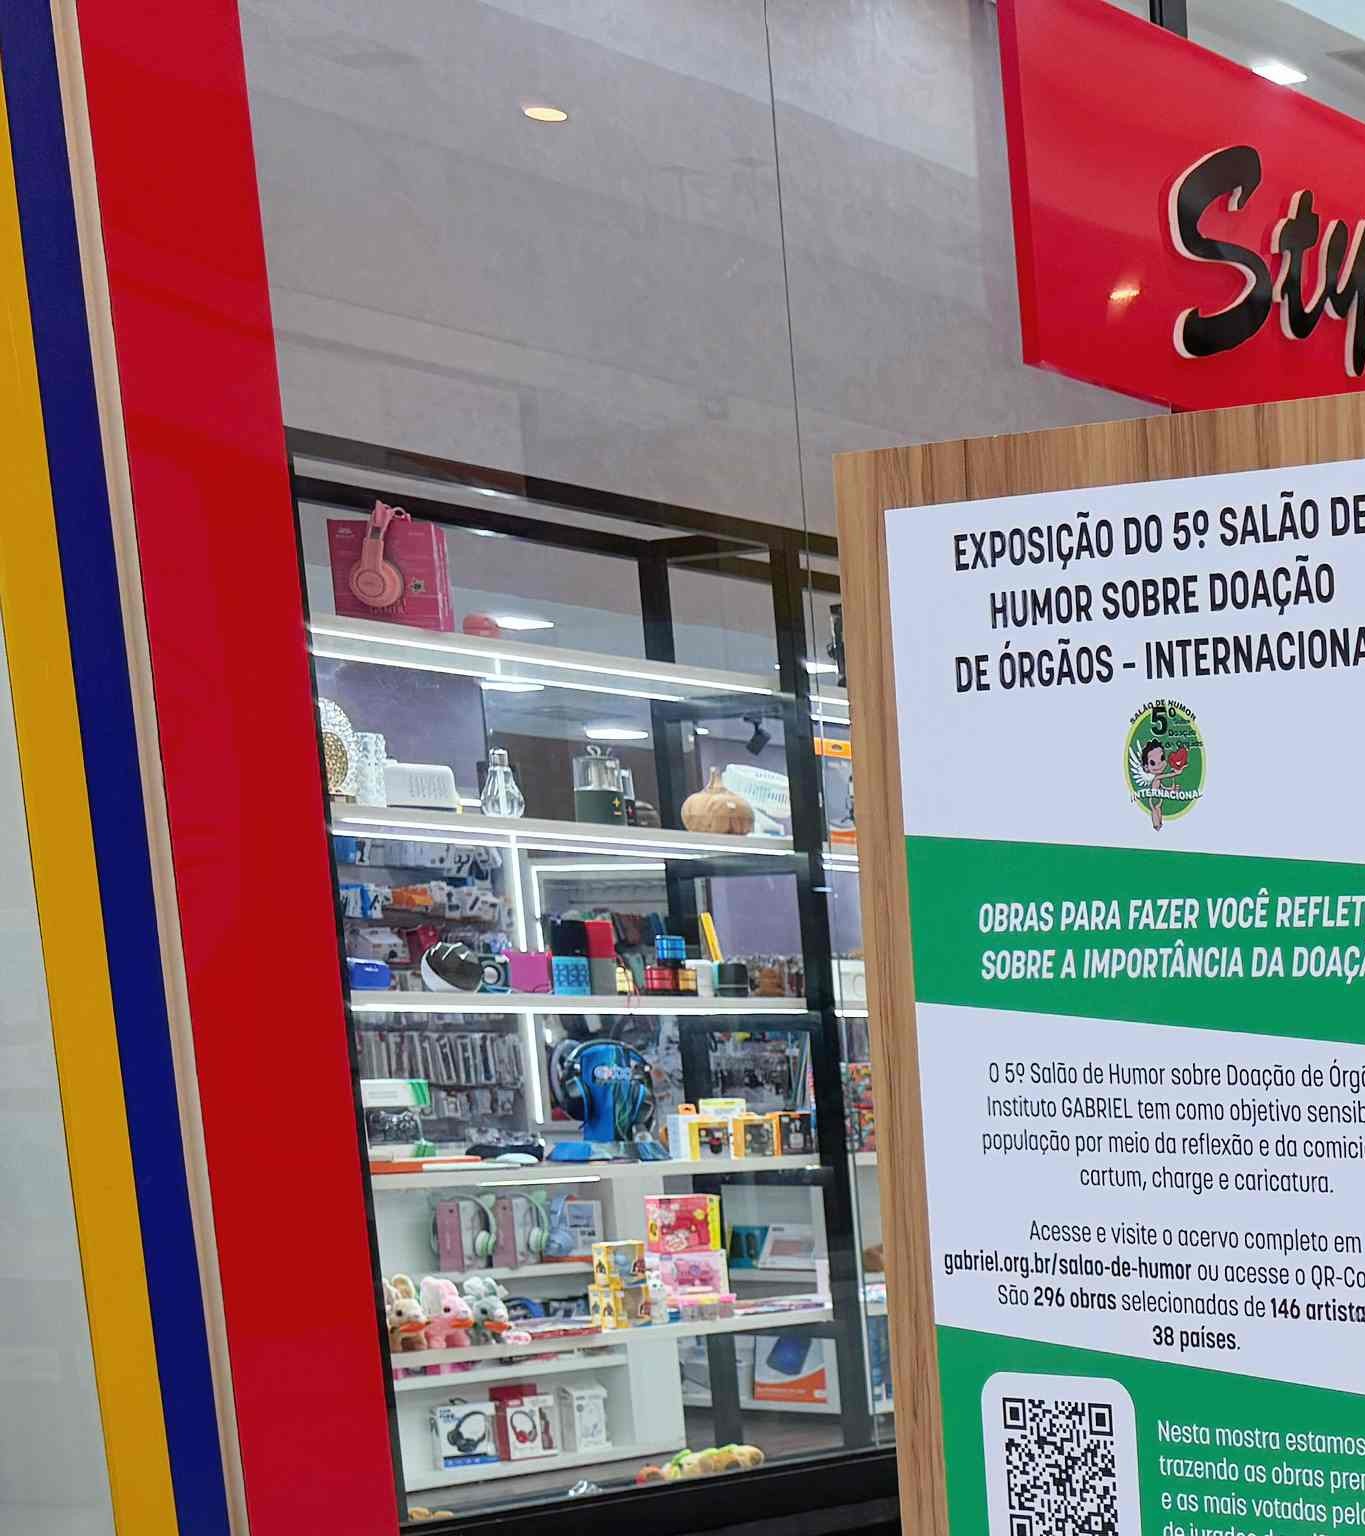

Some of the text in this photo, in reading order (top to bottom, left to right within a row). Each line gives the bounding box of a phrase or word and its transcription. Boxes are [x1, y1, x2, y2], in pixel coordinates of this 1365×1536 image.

[953, 511, 1114, 572] EXPOSIÇÃO
[1123, 514, 1163, 556] DO
[1173, 509, 1209, 551] 5º
[1219, 490, 1320, 547] SALÃO
[989, 554, 1335, 630] HUMOR SOBRE DOAÇÃO
[955, 654, 991, 693] DE
[999, 638, 1114, 690] ÓRGÃOS
[978, 901, 1054, 934] OBRAS
[1060, 899, 1122, 932] PARA
[1128, 898, 1200, 930] FAZER
[1206, 887, 1270, 929] VOCÊ
[981, 949, 1056, 980] SOBRE
[1059, 948, 1077, 979] A
[1083, 938, 1244, 979] IMPORTÂNCIA
[1251, 946, 1285, 978] DA
[989, 1062, 1000, 1084] O
[1005, 1062, 1025, 1084] 5º
[1030, 1061, 1078, 1084] Salão
[1082, 1061, 1104, 1085] de
[1108, 1063, 1166, 1086] Humor
[1171, 1062, 1221, 1086] sobre
[1226, 1064, 1296, 1092] Doação
[1301, 1063, 1324, 1088] de
[987, 1095, 1057, 1118] Instituto
[1061, 1096, 1134, 1119] GABRIEL
[1137, 1099, 1171, 1120] tem
[1175, 1102, 1224, 1121] como
[1229, 1097, 1302, 1128] objetivo
[982, 1128, 1070, 1156] população
[1075, 1135, 1103, 1157] por
[1108, 1135, 1150, 1154] meio
[1154, 1131, 1177, 1154] da
[1182, 1132, 1254, 1157] reflexão
[1259, 1139, 1270, 1157] e
[1275, 1133, 1298, 1158] da
[1080, 1166, 1334, 1196] cartum, charge e caricatura.
[1029, 1219, 1362, 1257] Acesse e visite o acervo completo em
[944, 1249, 1192, 1281] gabriel.org.br/salao-de-humor
[1197, 1263, 1219, 1282] ou
[1224, 1265, 1290, 1285] acesse
[1295, 1268, 1306, 1286] o
[997, 1284, 1029, 1306] São
[1033, 1286, 1065, 1308] 296
[1070, 1286, 1117, 1311] obras
[1121, 1289, 1239, 1317] selecionadas
[1244, 1295, 1266, 1318] de
[1270, 1297, 1301, 1320] 146
[1152, 1324, 1241, 1353] 38 países.
[1157, 1419, 1211, 1445] Nesta
[1215, 1427, 1281, 1450] mostra
[1159, 1455, 1239, 1481] trazendo
[1244, 1464, 1267, 1484] as
[1271, 1461, 1325, 1488] obras
[1161, 1492, 1172, 1510] e
[1176, 1493, 1199, 1513] as
[1203, 1492, 1248, 1516] mais
[1251, 1497, 1328, 1523] votadas
